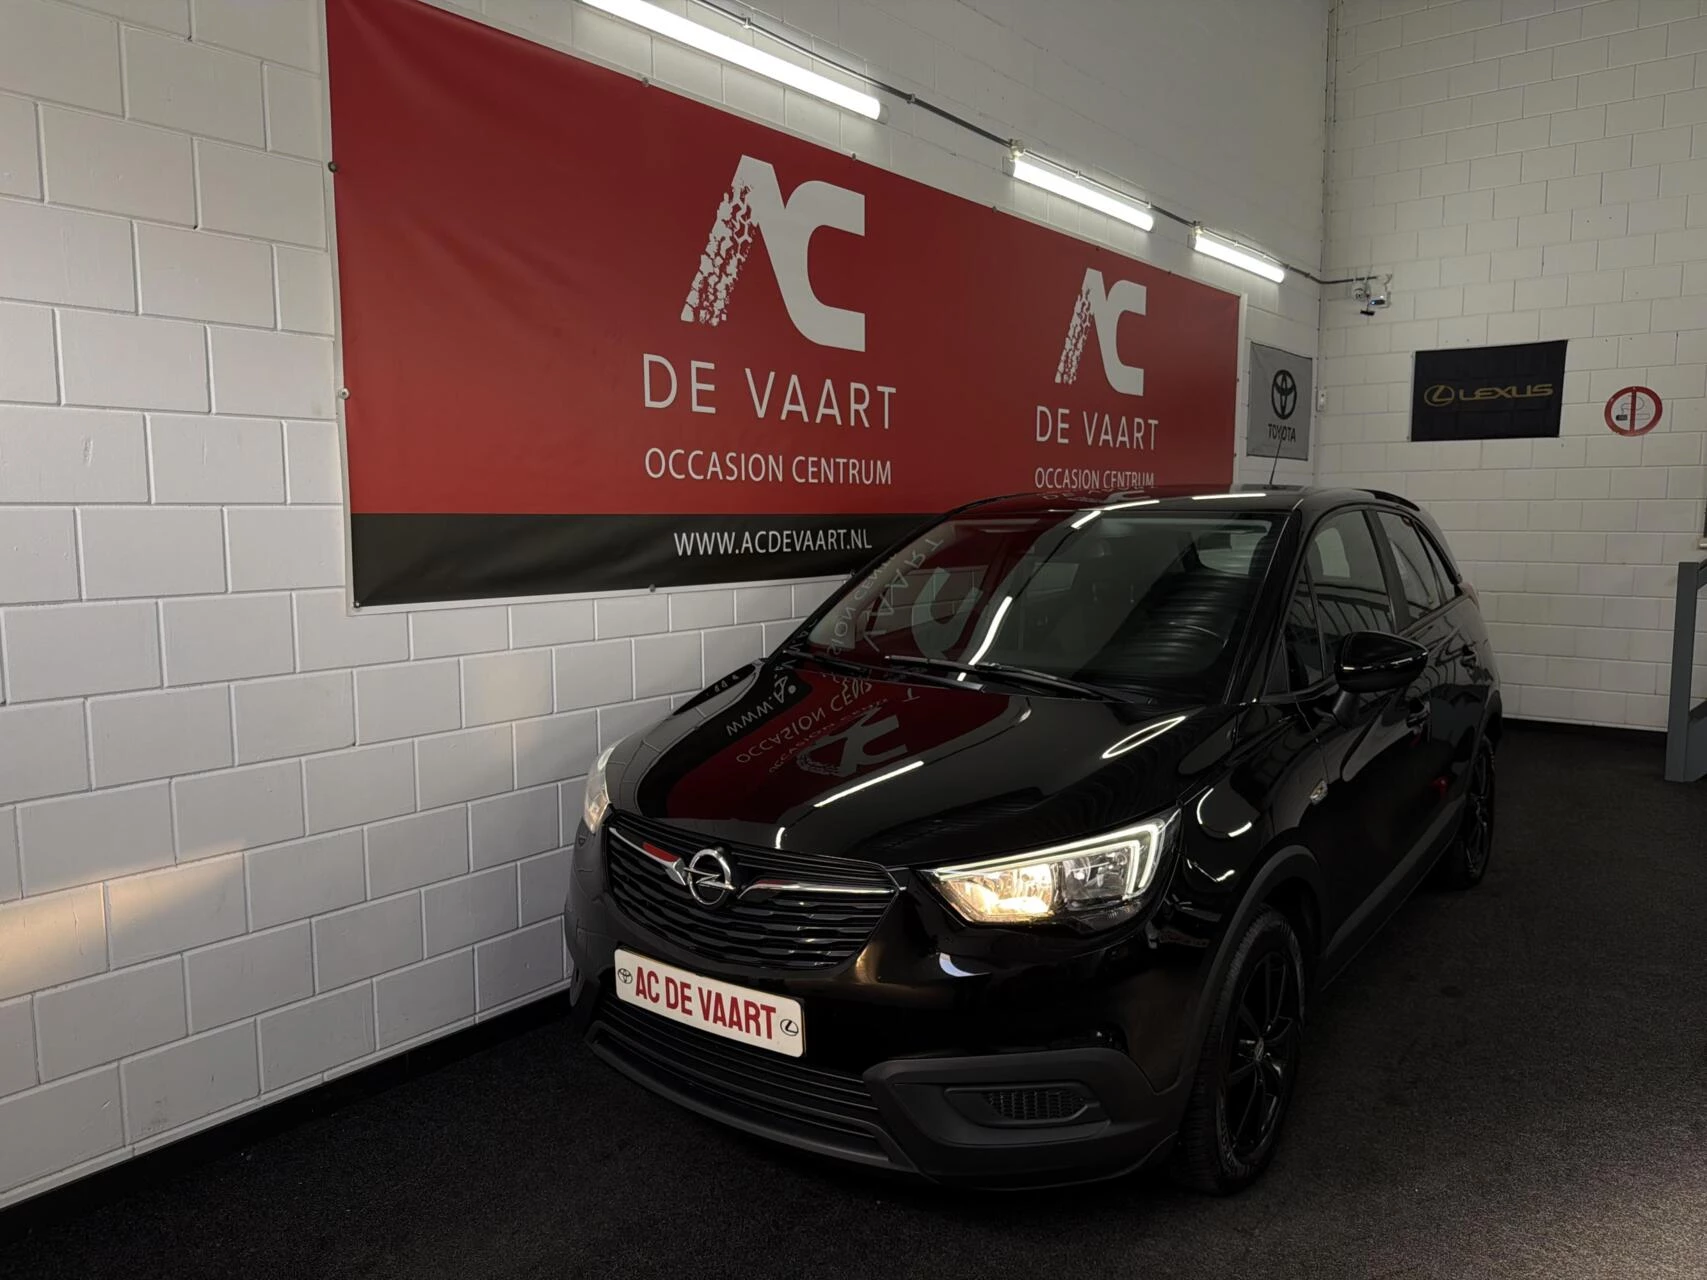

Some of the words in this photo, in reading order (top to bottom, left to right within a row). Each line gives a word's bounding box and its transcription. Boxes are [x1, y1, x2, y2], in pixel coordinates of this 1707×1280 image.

[680, 154, 866, 352] AC
[1054, 268, 1147, 397] AC
[642, 353, 717, 415] DE
[745, 367, 897, 431] VAART
[1459, 383, 1554, 401] LEXUS
[1036, 405, 1070, 445] DE
[1082, 411, 1160, 451] VAART
[1268, 423, 1296, 442] TOYOTA
[644, 447, 784, 483] OCCASION
[792, 456, 892, 486] CENTRUM
[1034, 467, 1100, 489] OCCASION
[673, 528, 872, 557] WWW.ACDEVAART.NL
[635, 966, 660, 1004] AC
[665, 976, 693, 1016] DE
[697, 986, 777, 1040] VAART
